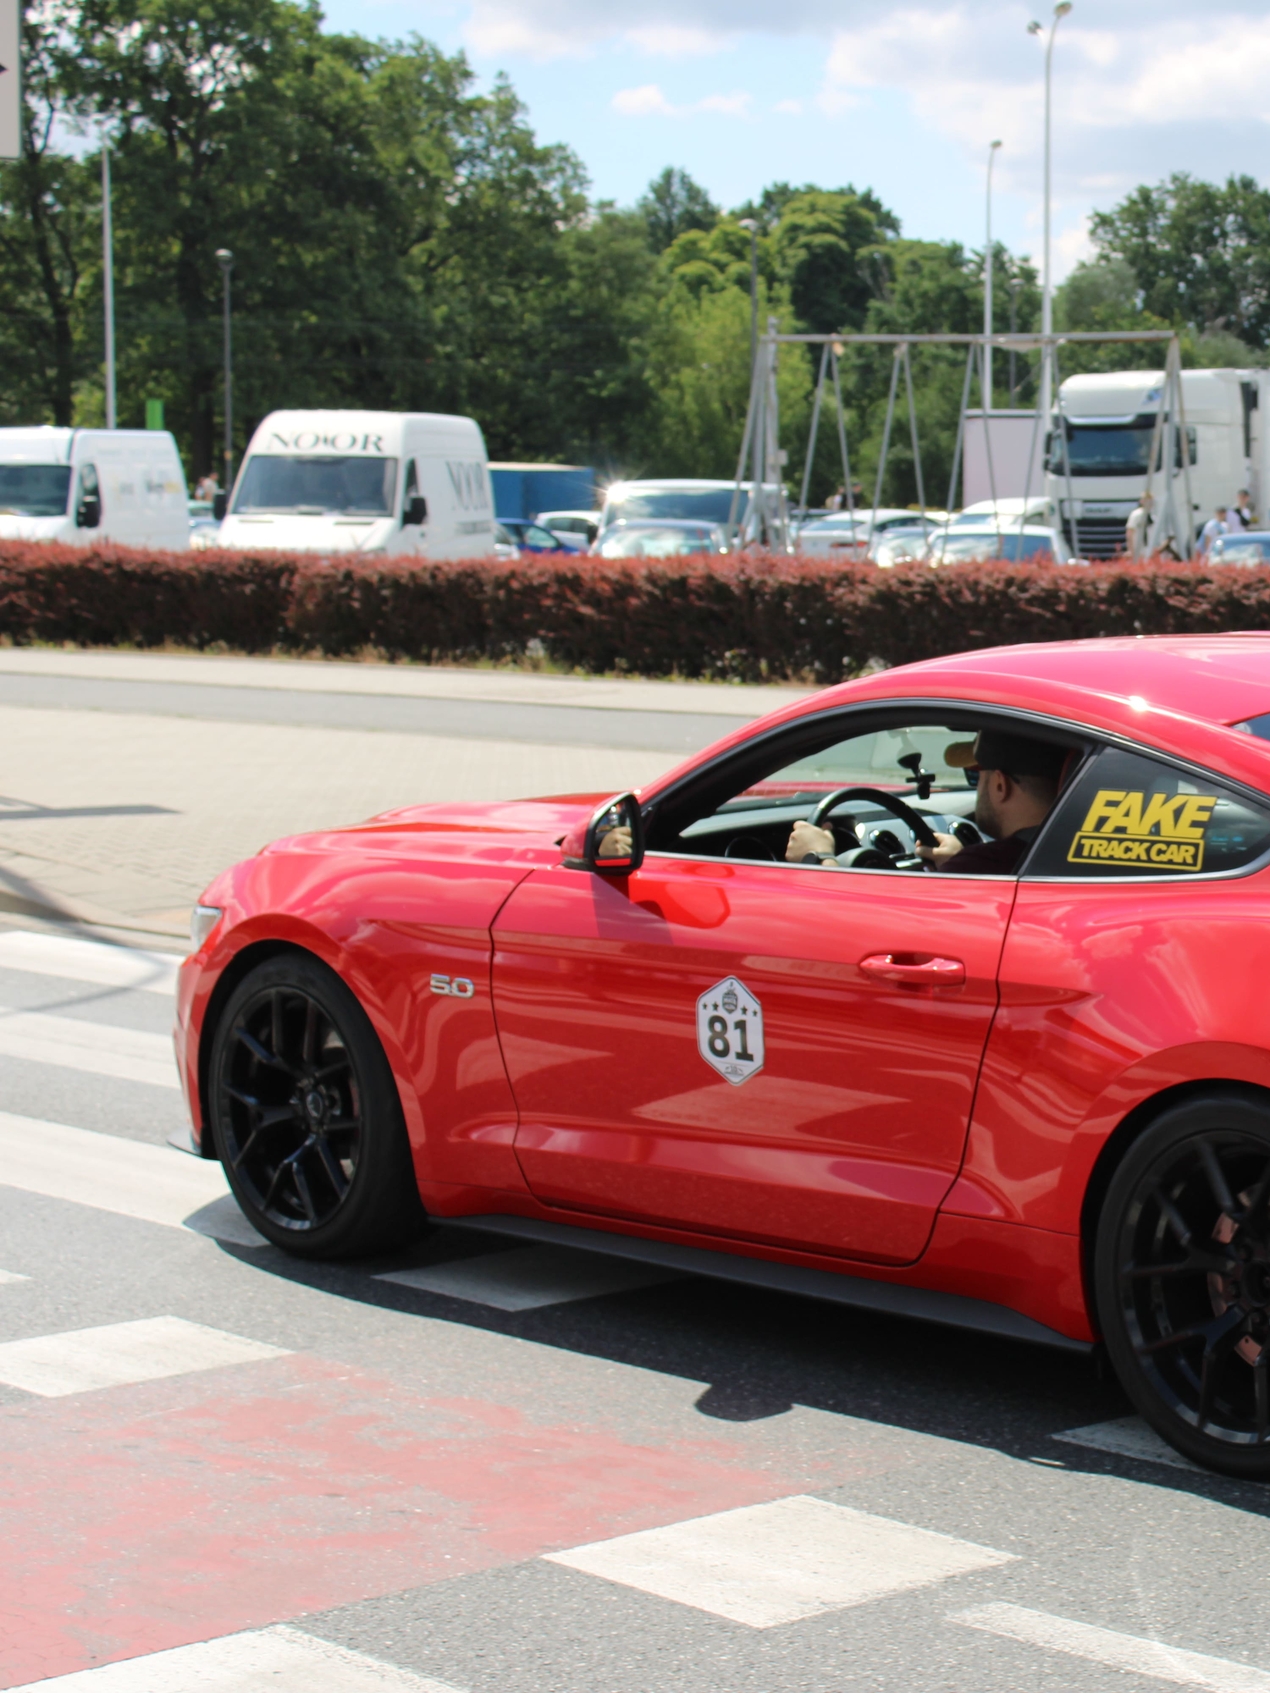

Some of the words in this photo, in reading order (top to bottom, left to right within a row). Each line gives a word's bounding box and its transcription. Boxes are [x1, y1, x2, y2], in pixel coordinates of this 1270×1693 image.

[1081, 790, 1217, 839] FAKE
[1080, 838, 1151, 861] TRACK
[1149, 843, 1195, 864] CAR
[707, 1015, 754, 1062] 81
